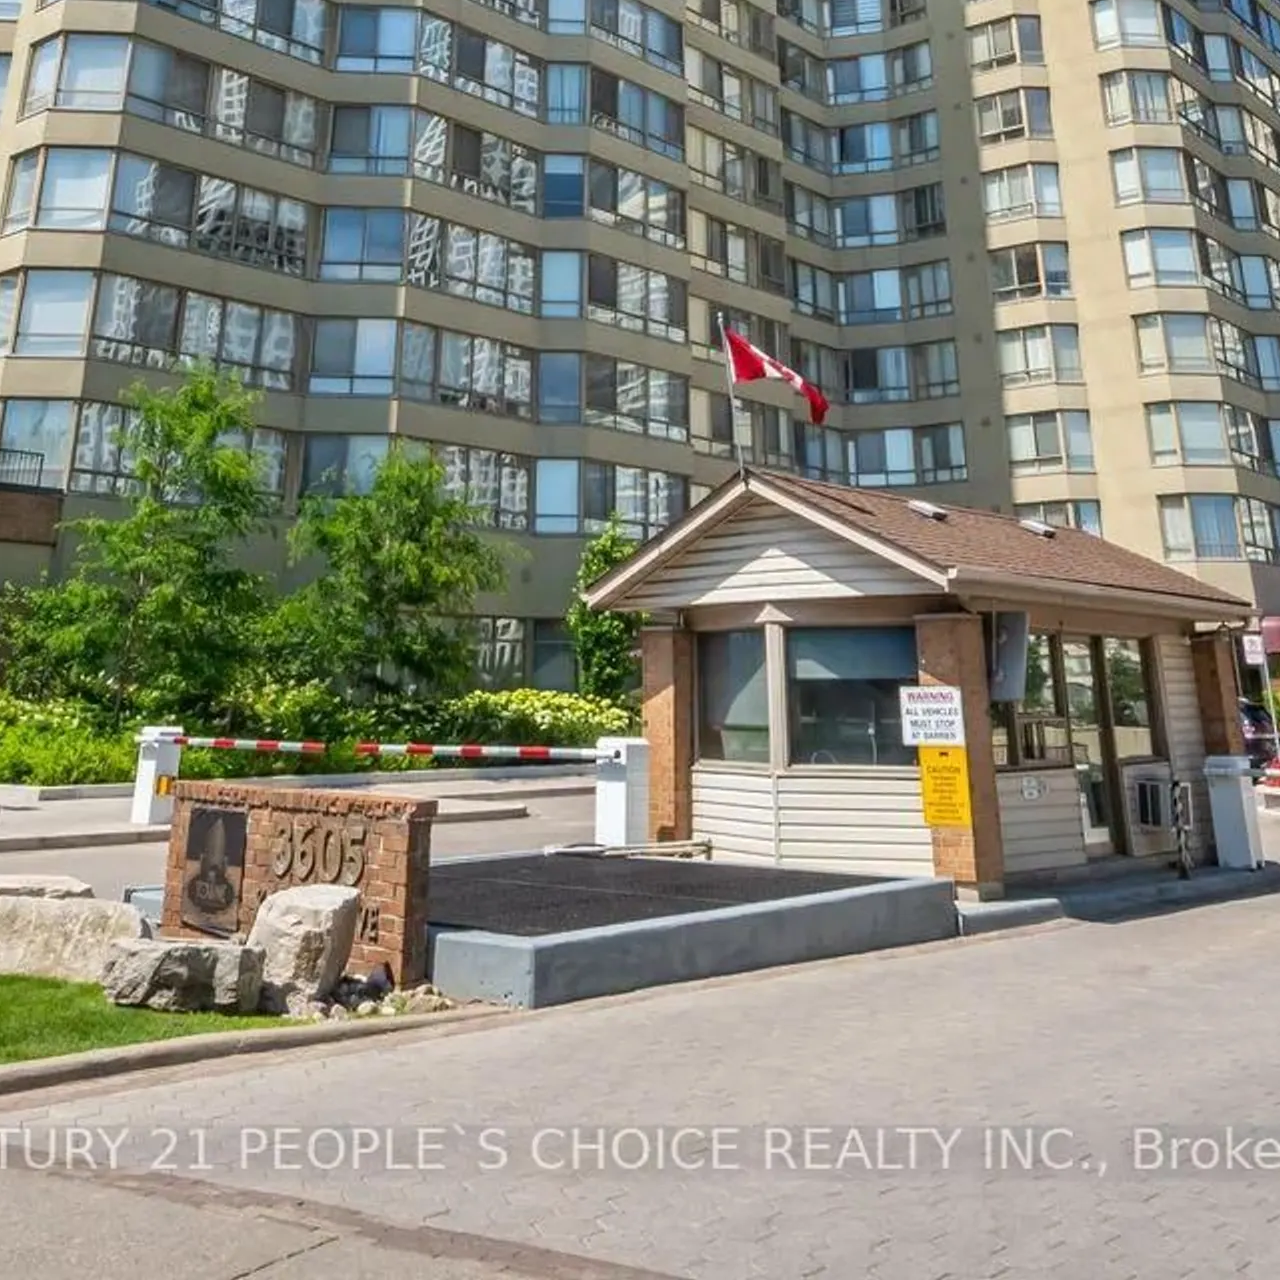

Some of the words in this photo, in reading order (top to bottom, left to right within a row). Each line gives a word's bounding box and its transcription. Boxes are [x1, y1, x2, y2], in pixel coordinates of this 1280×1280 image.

[907, 692, 954, 702] WARNING
[905, 707, 919, 716] ALL
[922, 707, 959, 717] VEHICLES
[910, 720, 931, 728] MUST
[935, 720, 956, 729] STOP
[271, 814, 368, 887] 3605
